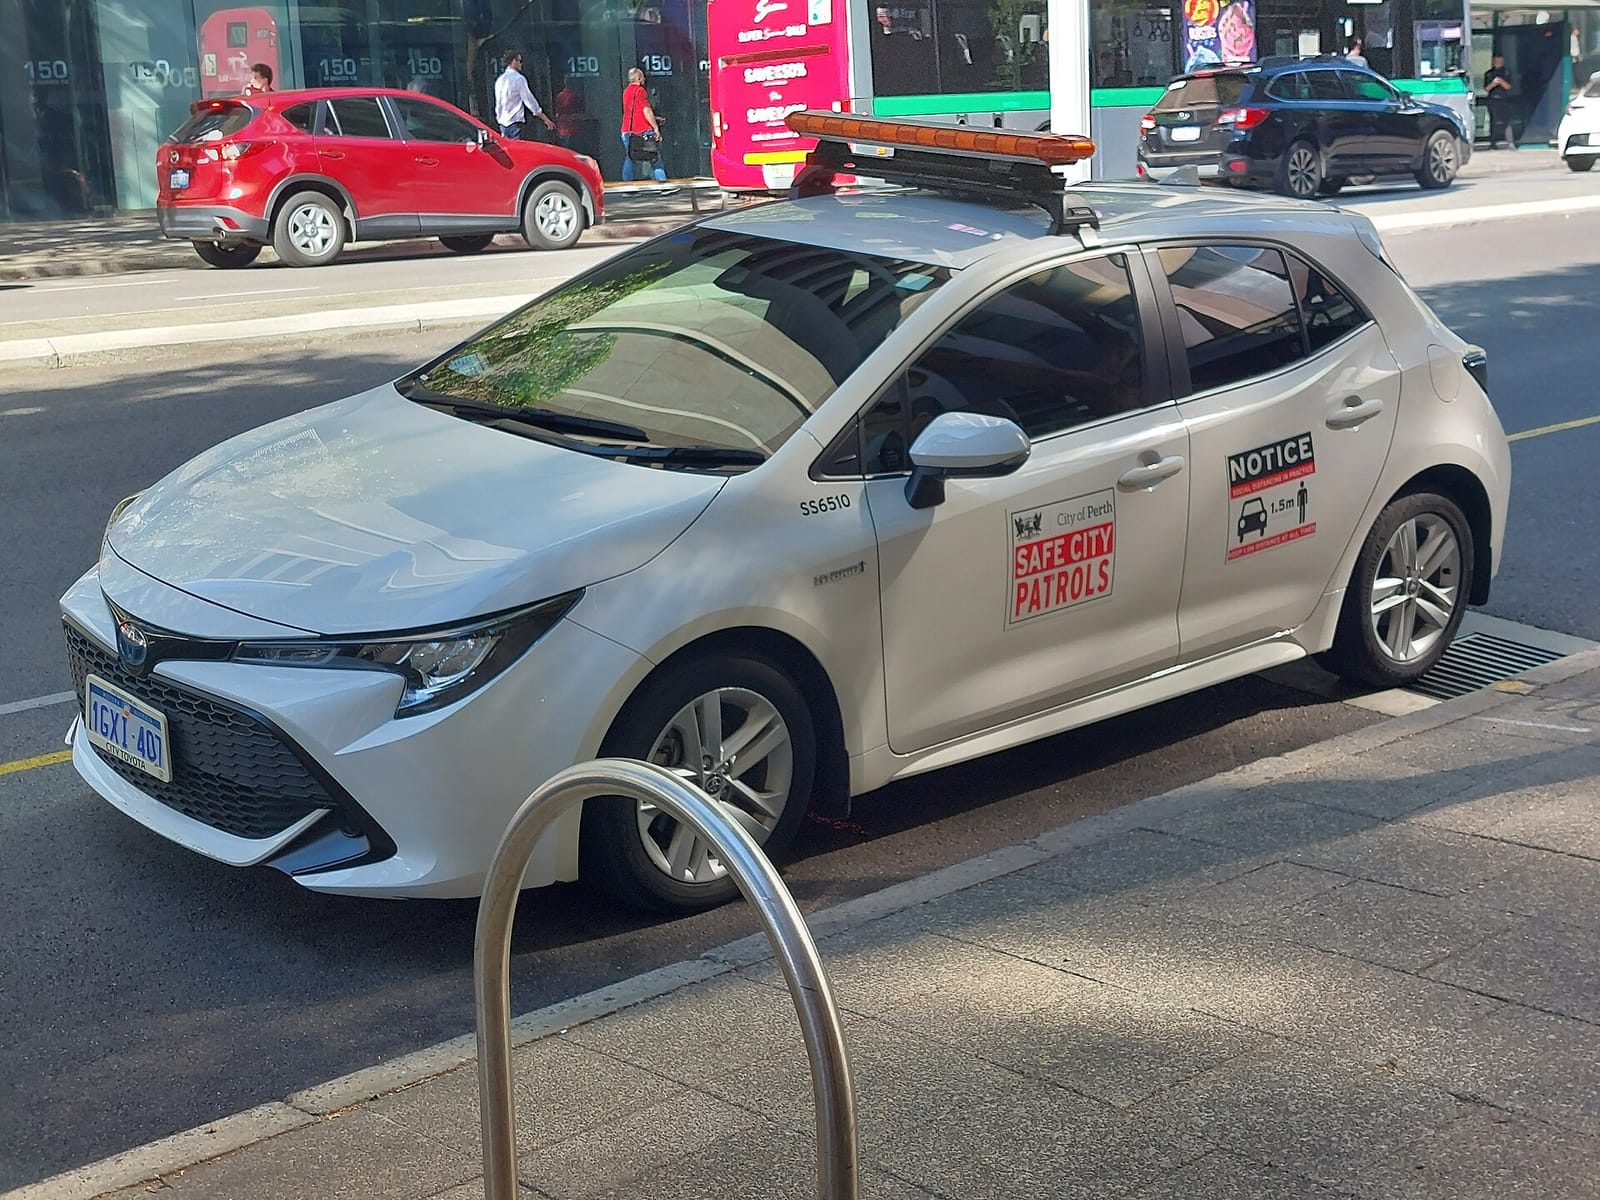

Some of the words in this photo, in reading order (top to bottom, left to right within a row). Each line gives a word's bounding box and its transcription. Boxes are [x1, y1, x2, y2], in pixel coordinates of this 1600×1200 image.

[24, 60, 68, 79] 150
[319, 58, 357, 76] 150
[407, 57, 442, 74] 150
[567, 56, 599, 73] 150
[641, 55, 672, 71] 150
[1230, 437, 1313, 482] NOTICE
[800, 494, 851, 516] SS6510
[1057, 512, 1076, 527] City
[1076, 507, 1086, 521] of
[1087, 500, 1113, 519] Perth
[1270, 498, 1295, 514] 1.5m
[1016, 538, 1065, 576] SAFE
[1070, 525, 1113, 562] CITY
[1016, 559, 1109, 616] PATROLS
[105, 742, 120, 757] CITY
[120, 748, 146, 770] TOYOTA
